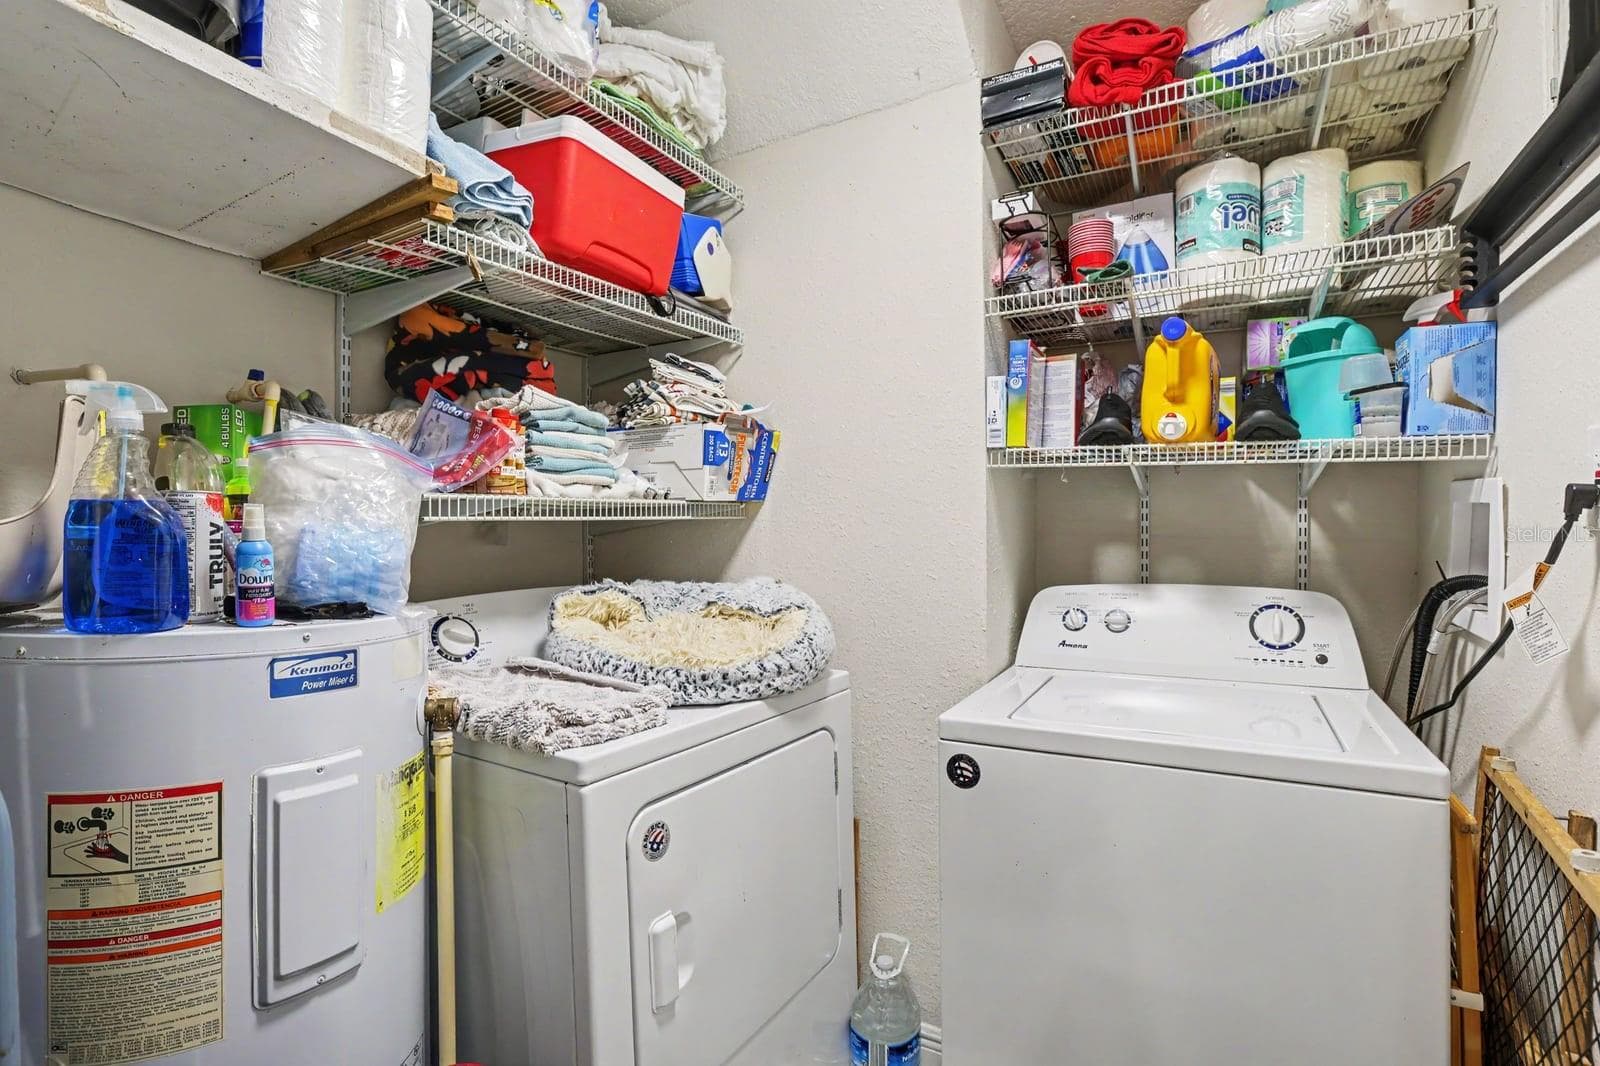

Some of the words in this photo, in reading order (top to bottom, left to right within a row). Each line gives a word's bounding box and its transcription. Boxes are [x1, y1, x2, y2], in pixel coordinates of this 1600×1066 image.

[177, 409, 187, 424] ED
[221, 408, 230, 440] BULBS
[235, 409, 243, 433] LED
[719, 441, 729, 457] 13
[758, 432, 768, 466] SCENTED
[750, 467, 763, 498] KITCHEN
[209, 522, 224, 589] TRULY
[1058, 640, 1088, 649] Amana
[290, 661, 353, 676] Kenmore
[301, 679, 327, 690] Power
[328, 676, 348, 687] Miser
[349, 674, 354, 683] 6
[120, 791, 164, 802] DANGER
[118, 934, 150, 944] DANGER
